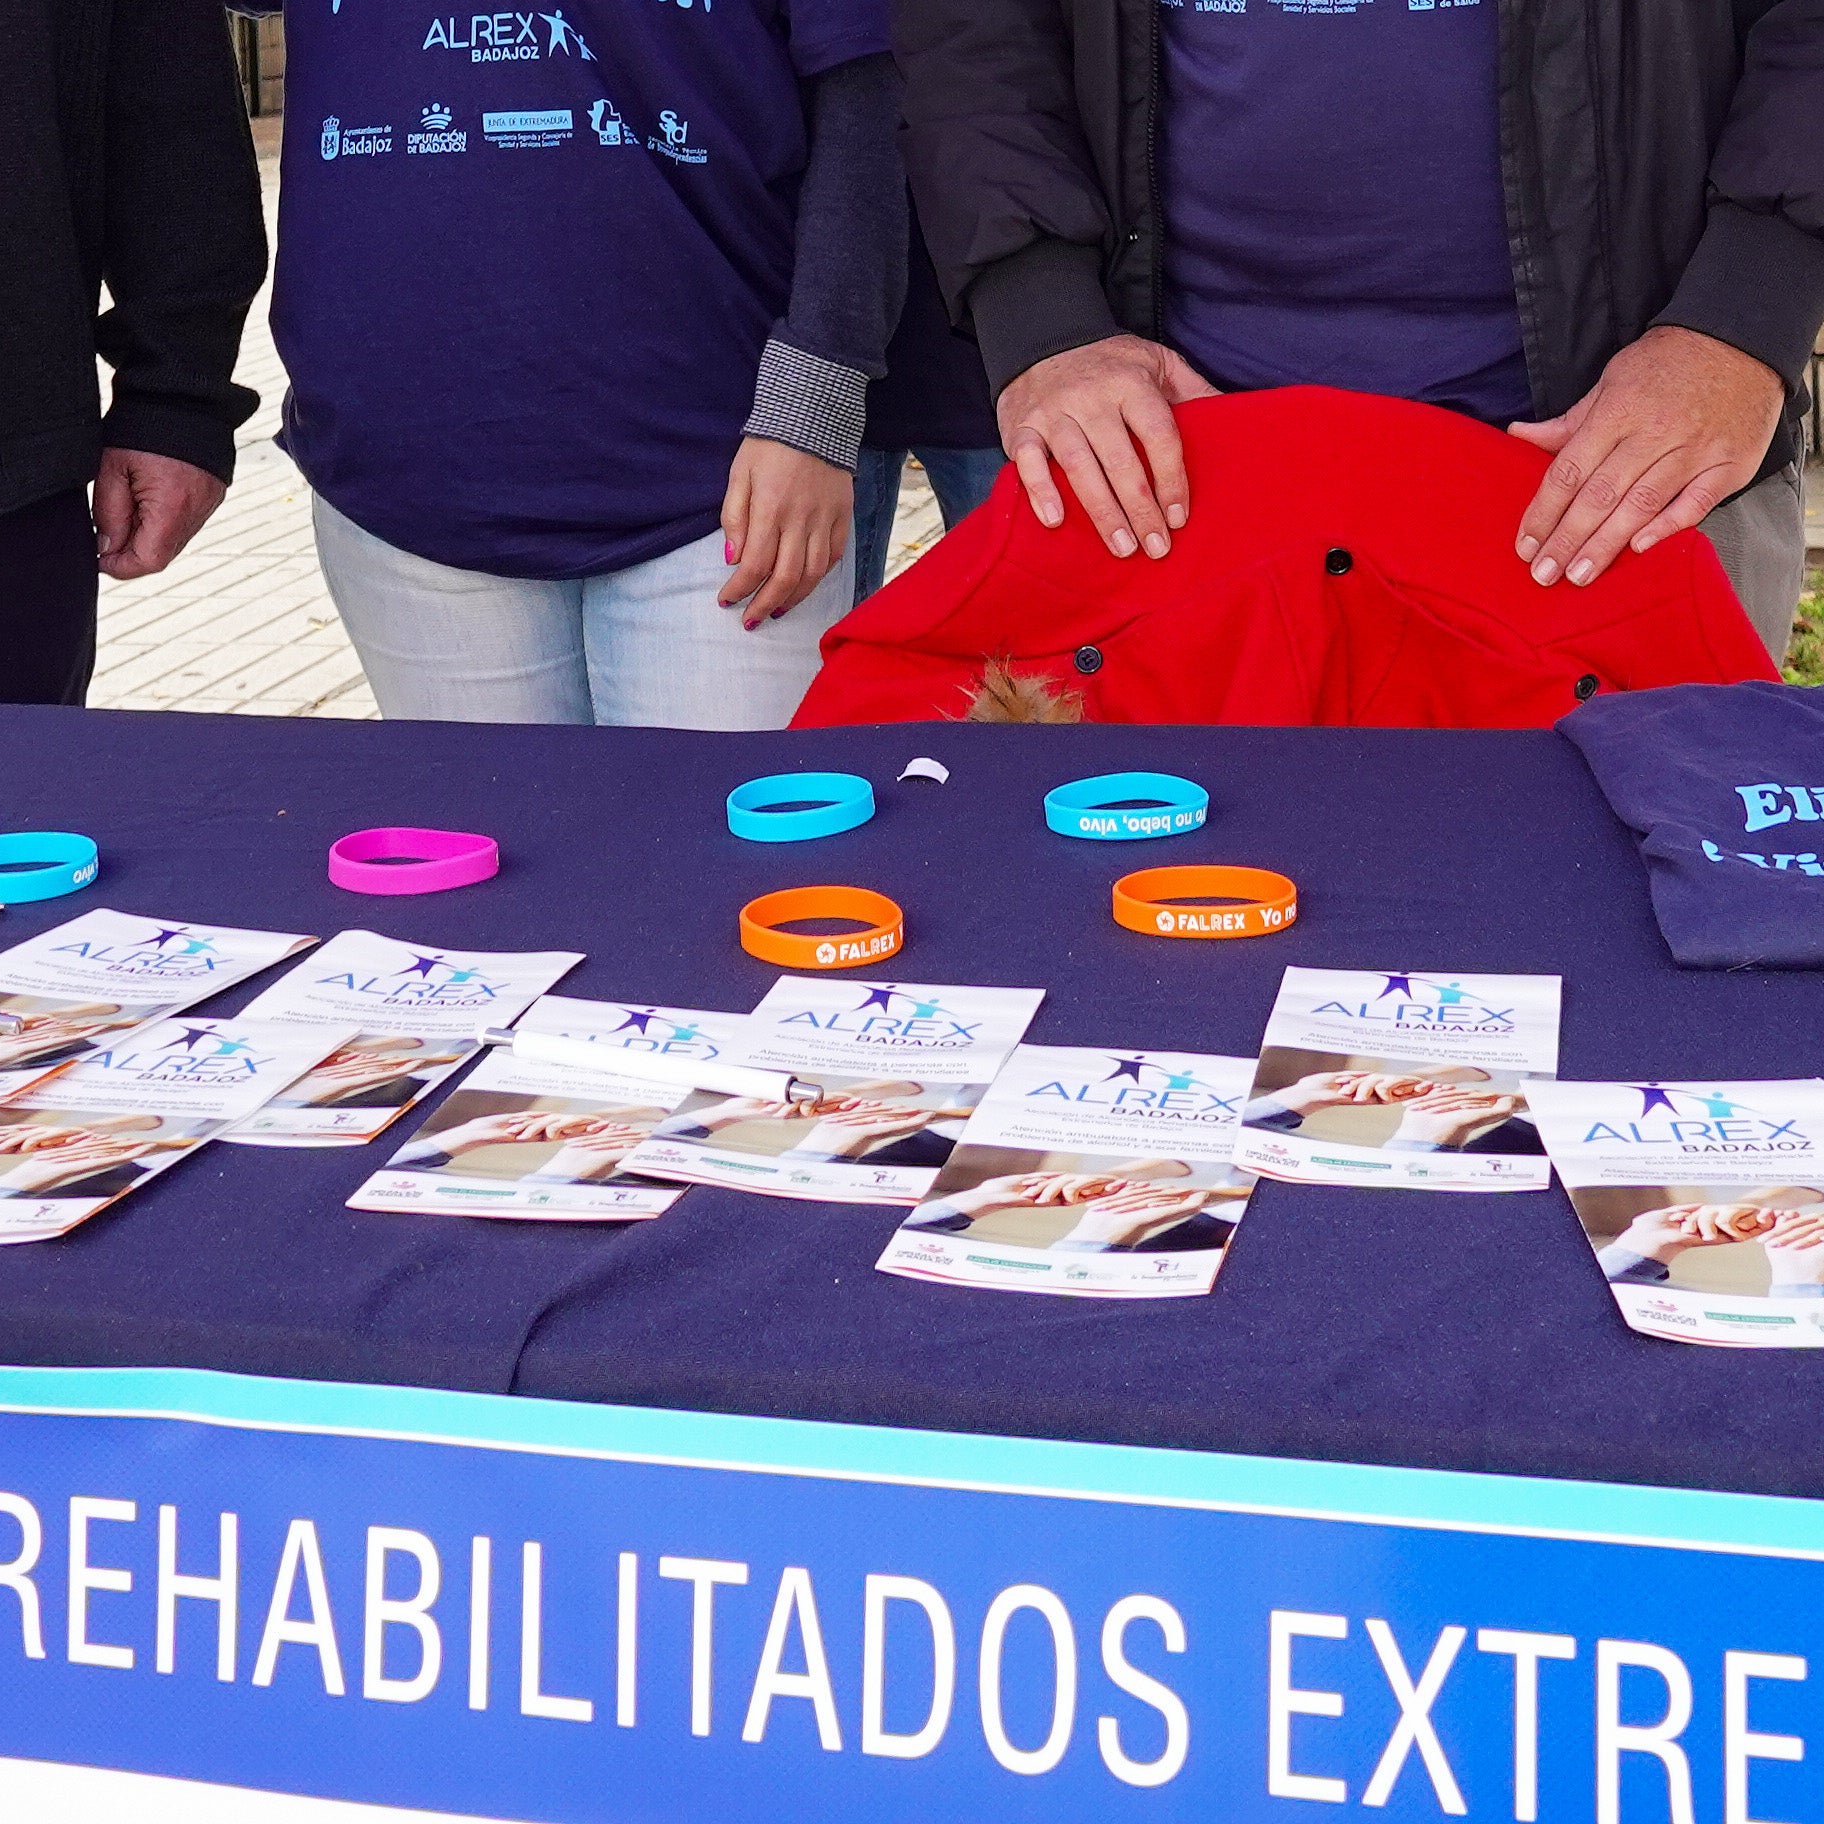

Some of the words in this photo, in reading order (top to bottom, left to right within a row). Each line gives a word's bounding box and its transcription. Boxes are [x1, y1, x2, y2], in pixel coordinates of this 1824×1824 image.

[1204, 0, 1246, 14] BADAJOZ
[1439, 0, 1452, 9] de
[422, 11, 537, 51] ALREX
[471, 45, 540, 63] BADAJOZ
[488, 118, 507, 128] JUNTA
[509, 118, 517, 127] DE
[519, 116, 569, 127] EXTREMADURA
[342, 137, 393, 156] Badajoz
[407, 129, 467, 146] DIPUTACIÓN
[601, 134, 619, 143] SES
[417, 142, 467, 154] BADAJOZ
[1079, 815, 1118, 836] vivo
[1123, 814, 1171, 835] bebo,
[1176, 811, 1194, 828] no
[1179, 913, 1245, 931] FALREX
[1259, 907, 1282, 928] Yo
[839, 932, 895, 961] FALREX
[51, 940, 234, 973] ALREX
[104, 961, 211, 980] BADAJOZ
[315, 972, 511, 999] ALREX
[382, 996, 494, 1008] BADAJOZ
[1311, 1001, 1516, 1025] ALREX
[778, 1010, 984, 1041] ALREX
[1395, 1022, 1516, 1033] BADAJOZ
[855, 1033, 975, 1049] BADAJOZ
[87, 1046, 259, 1075] ALREX
[134, 1069, 252, 1086] BADAJOZ
[1025, 1080, 1244, 1114] ALREX
[1110, 1106, 1239, 1124] BADAJOZ
[1583, 1119, 1808, 1143] ALREX
[1682, 1140, 1815, 1153] BADAJOZ
